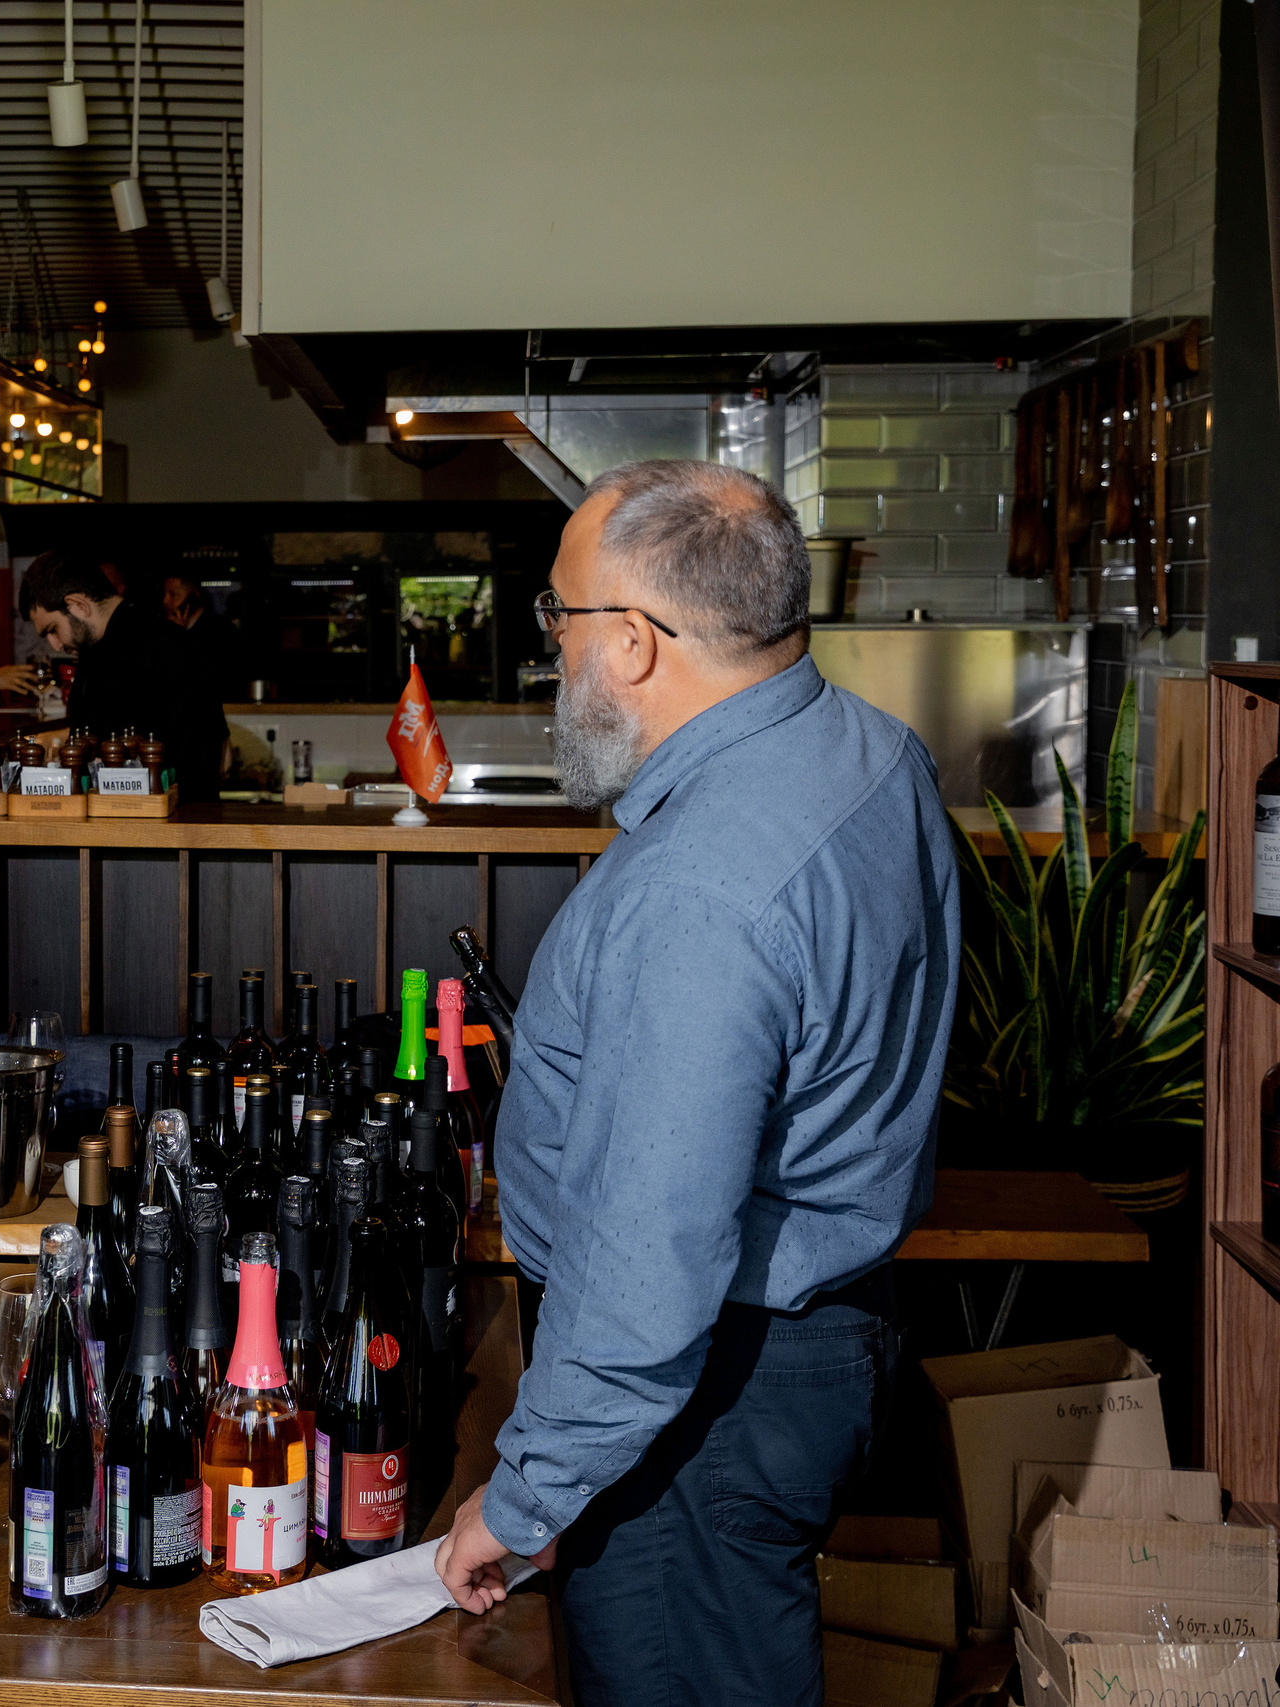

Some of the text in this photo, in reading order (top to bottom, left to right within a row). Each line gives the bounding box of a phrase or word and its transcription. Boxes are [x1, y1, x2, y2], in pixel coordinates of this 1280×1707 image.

[26, 785, 65, 795] MATADOR
[103, 780, 143, 791] MATADOR
[1056, 1402, 1065, 1418] 6
[1069, 1402, 1092, 1419] бут.
[1107, 1395, 1143, 1413] 0,75л.
[1176, 1615, 1184, 1631] 6
[1187, 1617, 1210, 1636] бут.
[1223, 1617, 1256, 1637] 0,75л
